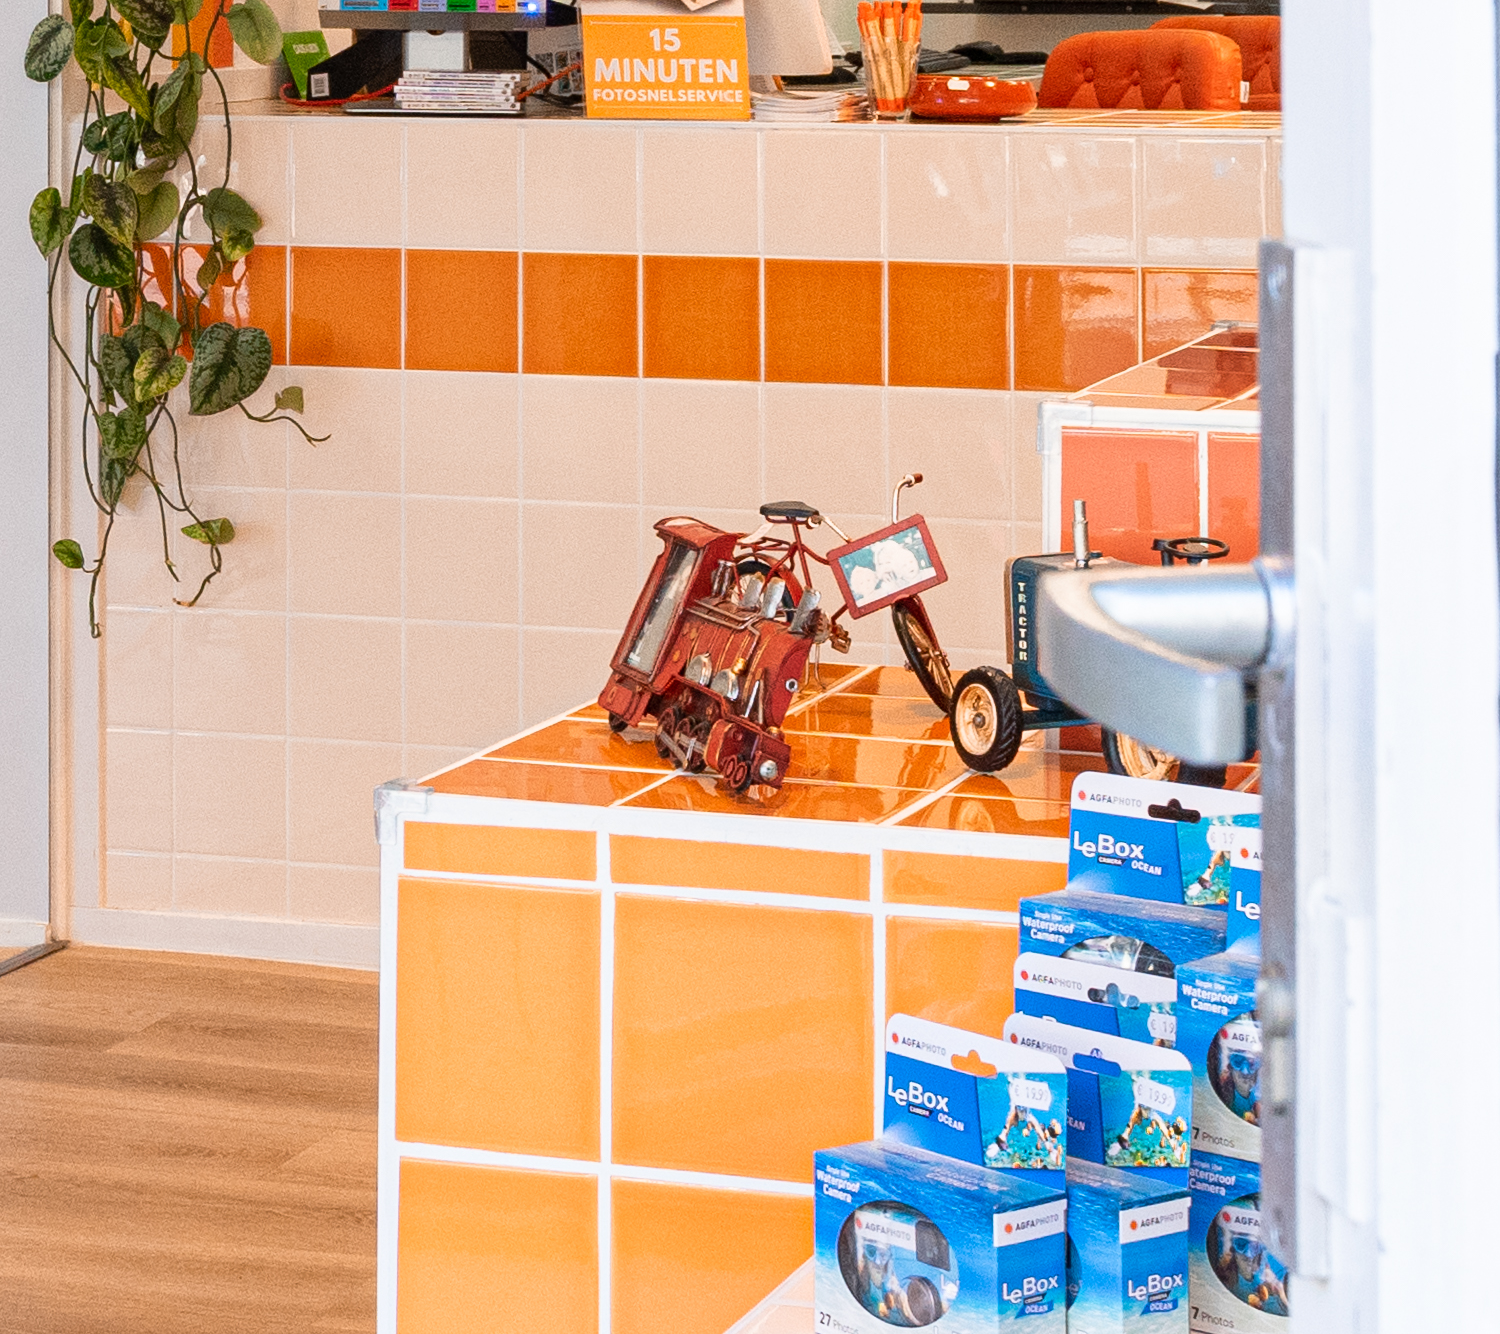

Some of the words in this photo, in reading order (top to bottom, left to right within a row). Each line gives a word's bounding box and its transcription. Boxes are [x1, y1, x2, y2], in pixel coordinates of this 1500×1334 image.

[649, 28, 682, 52] 15
[594, 57, 739, 83] MINUTEN
[593, 88, 744, 103] FOTOSNELSERVICE
[1016, 580, 1030, 662] TRACTOR
[1089, 792, 1142, 808] AGFAPHOTO
[1073, 830, 1145, 860] LeBox
[1131, 859, 1162, 876] OCEAN
[1022, 915, 1075, 934] Waterproof
[1030, 928, 1066, 944] Camera
[1031, 973, 1083, 991] AGFAPHOTO
[1182, 984, 1239, 1006] Waterproof
[1190, 997, 1229, 1016] Camera
[901, 1036, 947, 1057] AGFAPHOTO
[1020, 1037, 1068, 1056] AGFAPHOTO
[887, 1075, 950, 1113] LeBox
[937, 1112, 965, 1132] OCEAN
[1201, 1131, 1235, 1148] Photos
[816, 1168, 861, 1192] Waterproof
[1189, 1167, 1236, 1187] aterproof
[822, 1183, 852, 1203] Camera
[1190, 1178, 1226, 1196] Camera
[1015, 1213, 1060, 1231] AGFAPHOTO
[1139, 1211, 1184, 1228] AGFAPHOTO
[864, 1221, 912, 1241] AGFAPHOTO
[1002, 1275, 1059, 1304] LeBox
[1128, 1273, 1184, 1301] LeBox
[1024, 1304, 1049, 1315] OCEAN
[1149, 1301, 1174, 1312] OCEAN
[819, 1311, 832, 1327] 27
[1201, 1313, 1235, 1328] Photos
